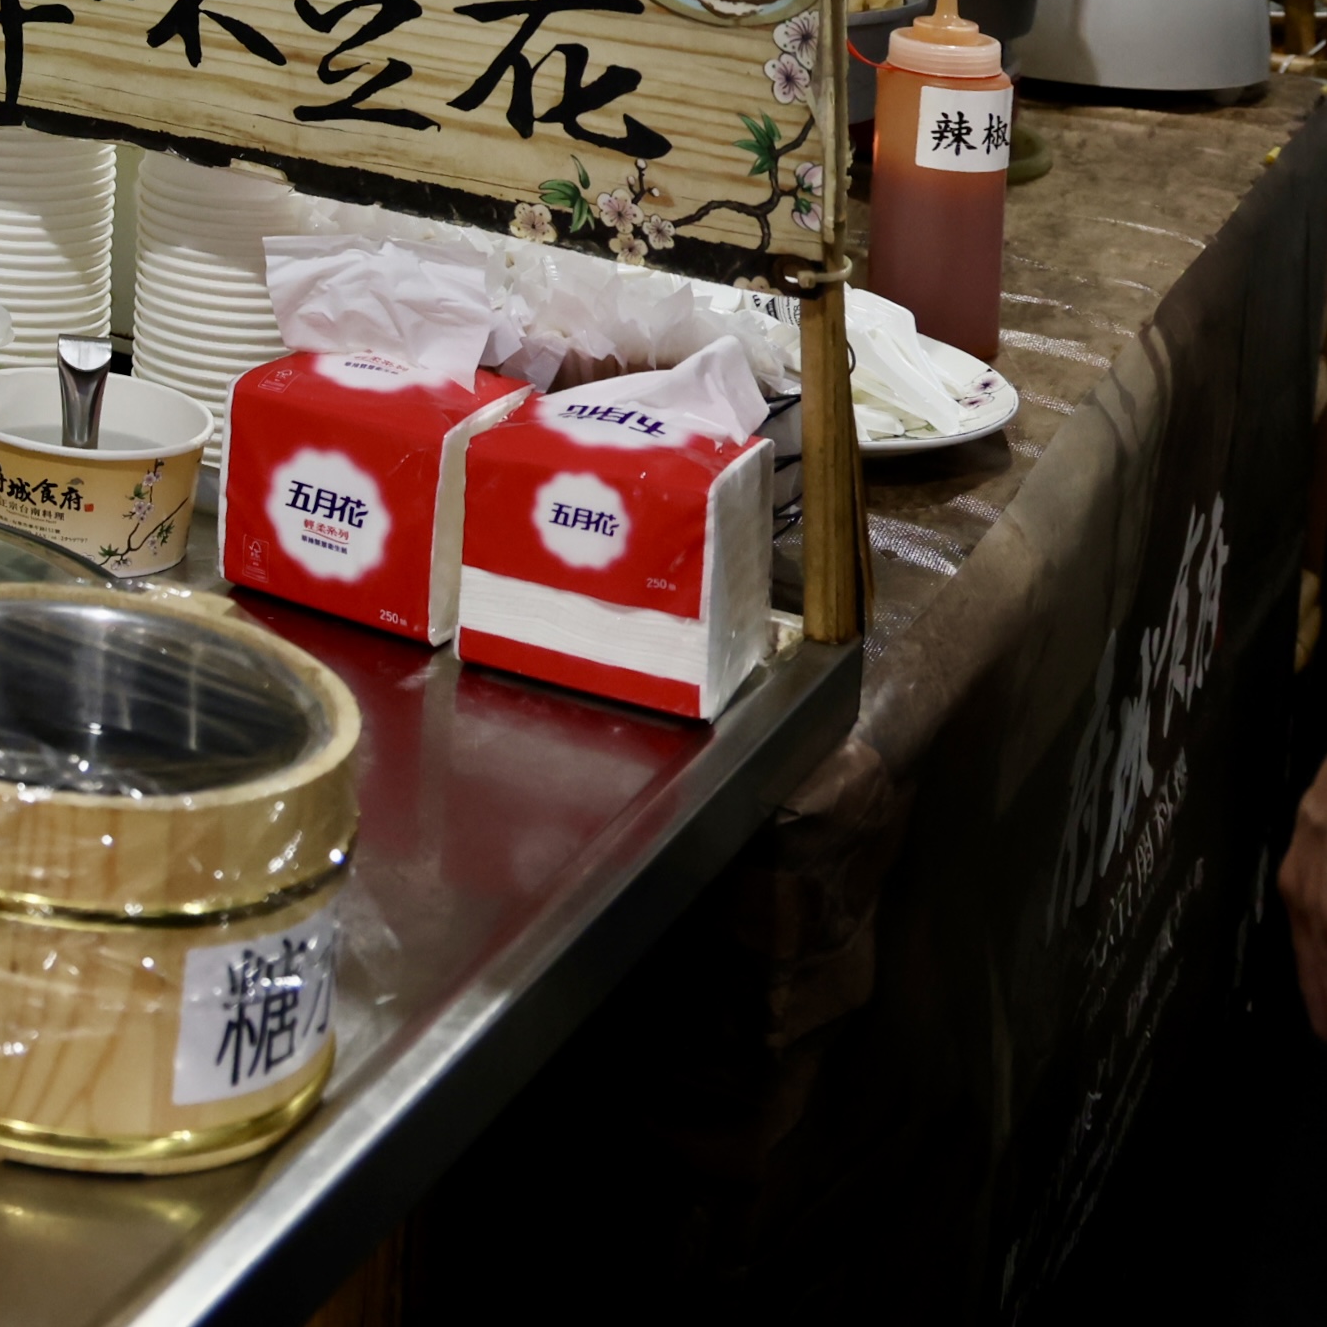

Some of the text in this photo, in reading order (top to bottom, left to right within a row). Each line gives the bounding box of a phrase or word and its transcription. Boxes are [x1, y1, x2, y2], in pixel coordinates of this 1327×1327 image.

[930, 110, 1010, 156] 辣椒
[284, 479, 369, 529] 五月花
[548, 501, 620, 538] 五月花
